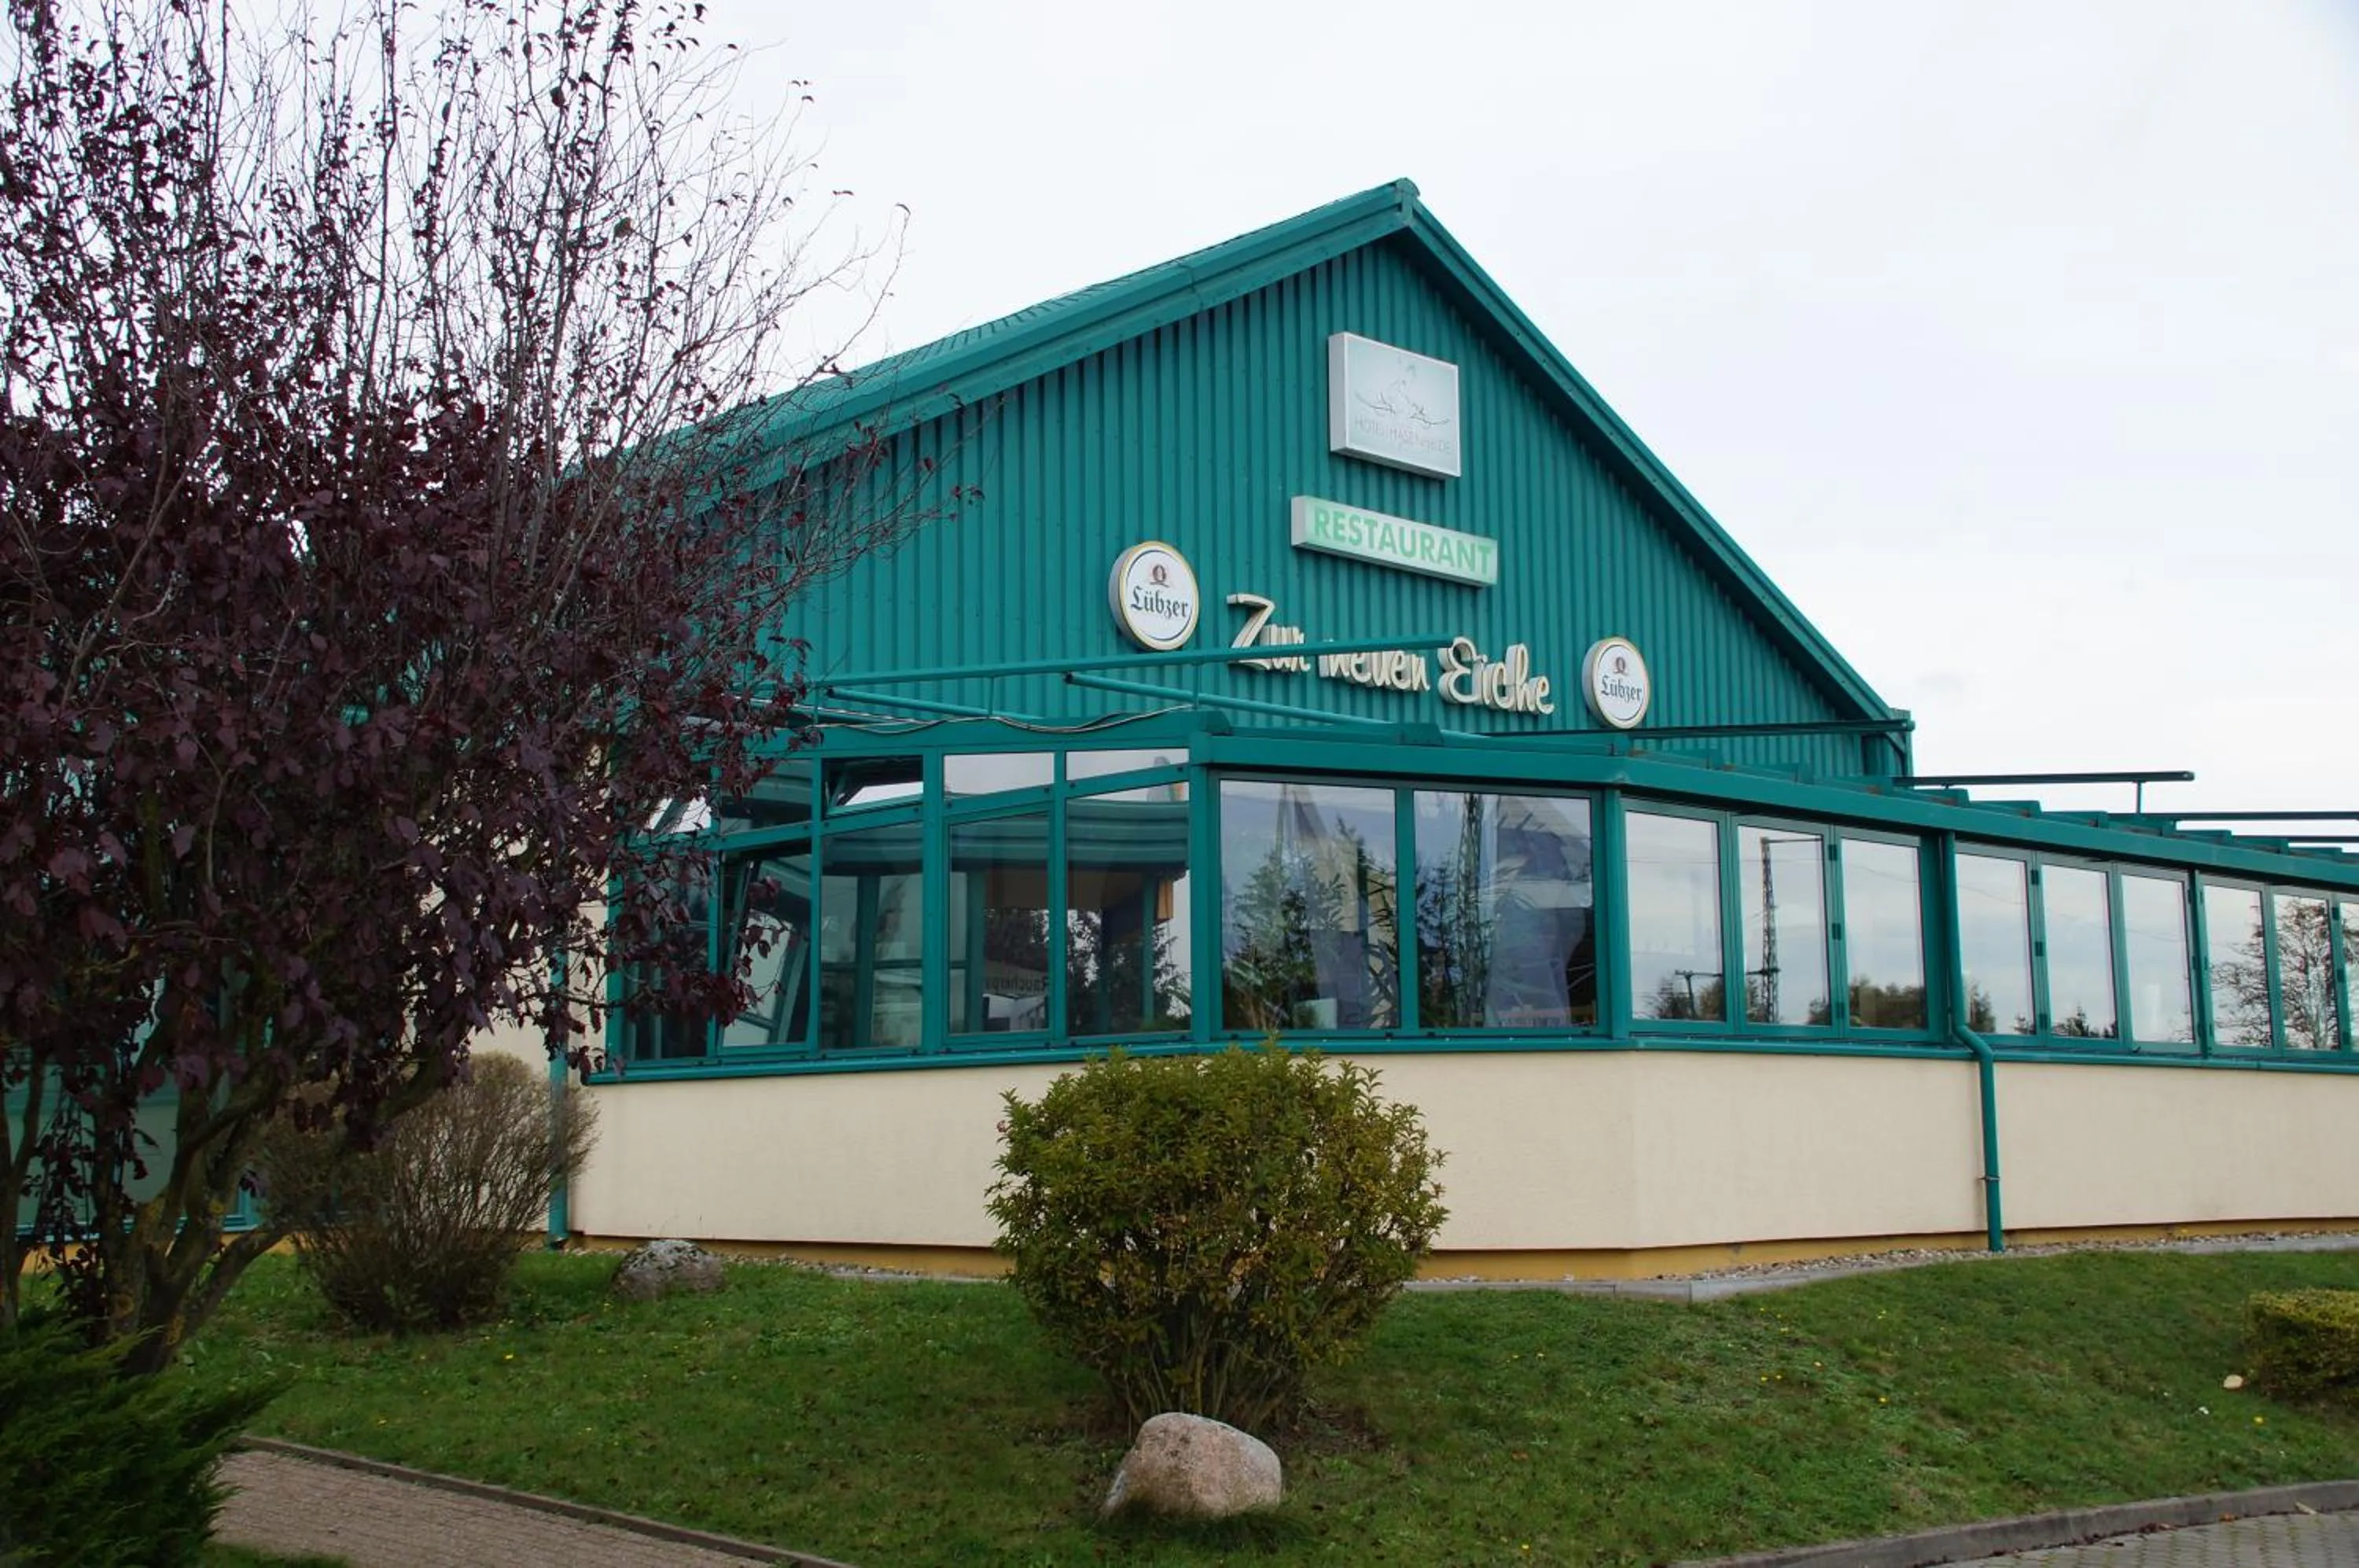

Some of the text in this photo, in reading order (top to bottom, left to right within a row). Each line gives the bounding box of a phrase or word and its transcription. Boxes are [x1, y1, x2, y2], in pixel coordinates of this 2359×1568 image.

[1314, 507, 1492, 576] RESTAURANT
[1131, 585, 1188, 619] Lübzer
[1437, 637, 1554, 714] Eiche
[1601, 675, 1642, 703] Lübzer
